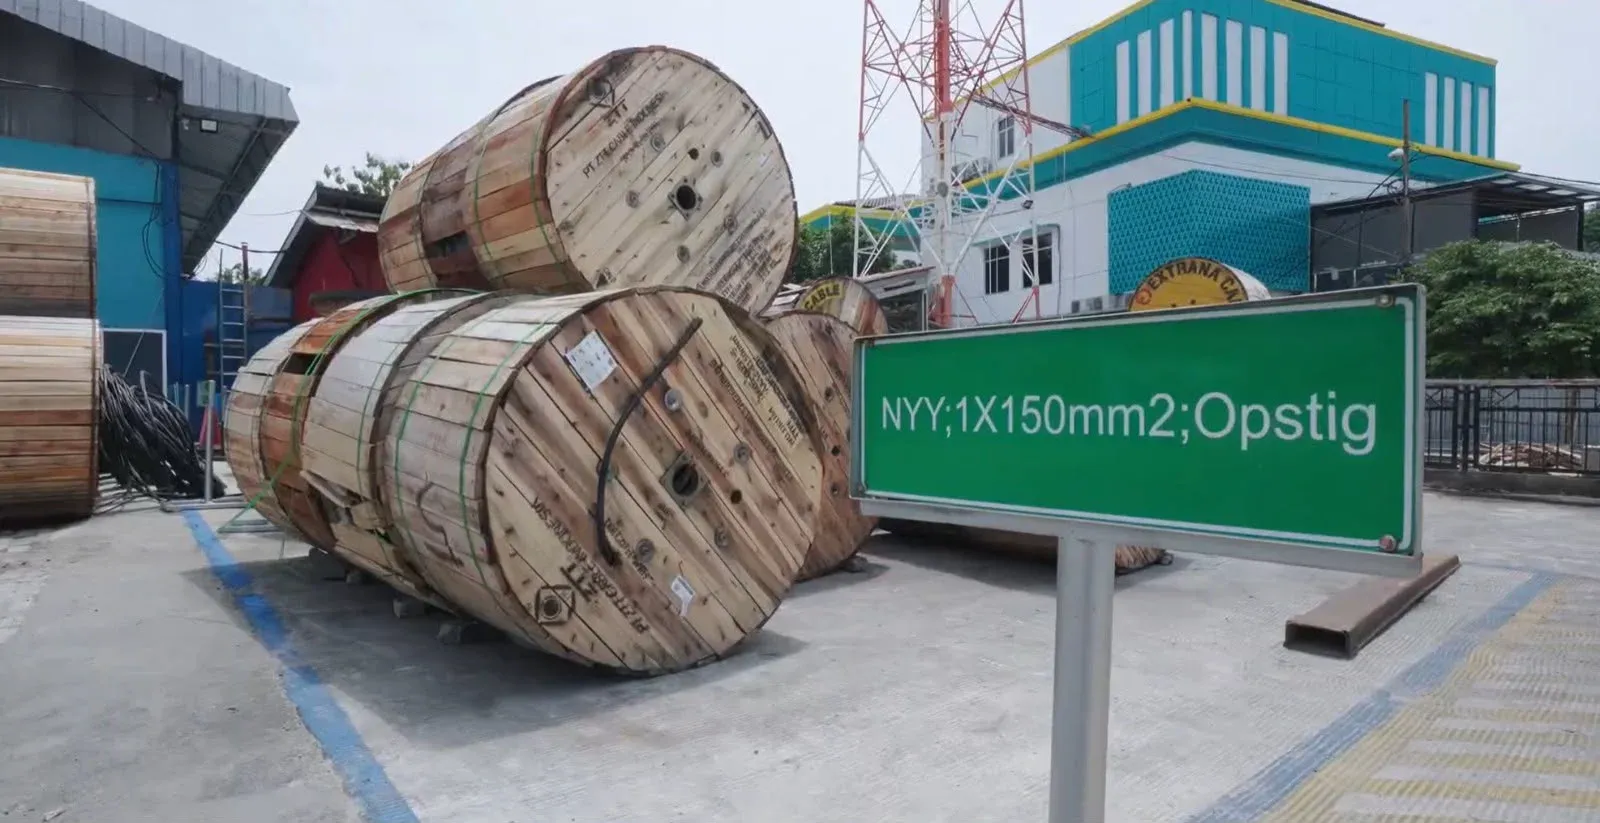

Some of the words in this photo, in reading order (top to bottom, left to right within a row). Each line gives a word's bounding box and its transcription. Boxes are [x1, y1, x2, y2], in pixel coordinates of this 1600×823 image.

[582, 162, 596, 178] PT
[804, 283, 841, 310] CABLE
[1149, 260, 1219, 290] EXTRANA
[1221, 275, 1243, 304] CA
[881, 391, 1377, 456] NYY;1X150mm2;Opstig
[566, 562, 599, 597] ZTT
